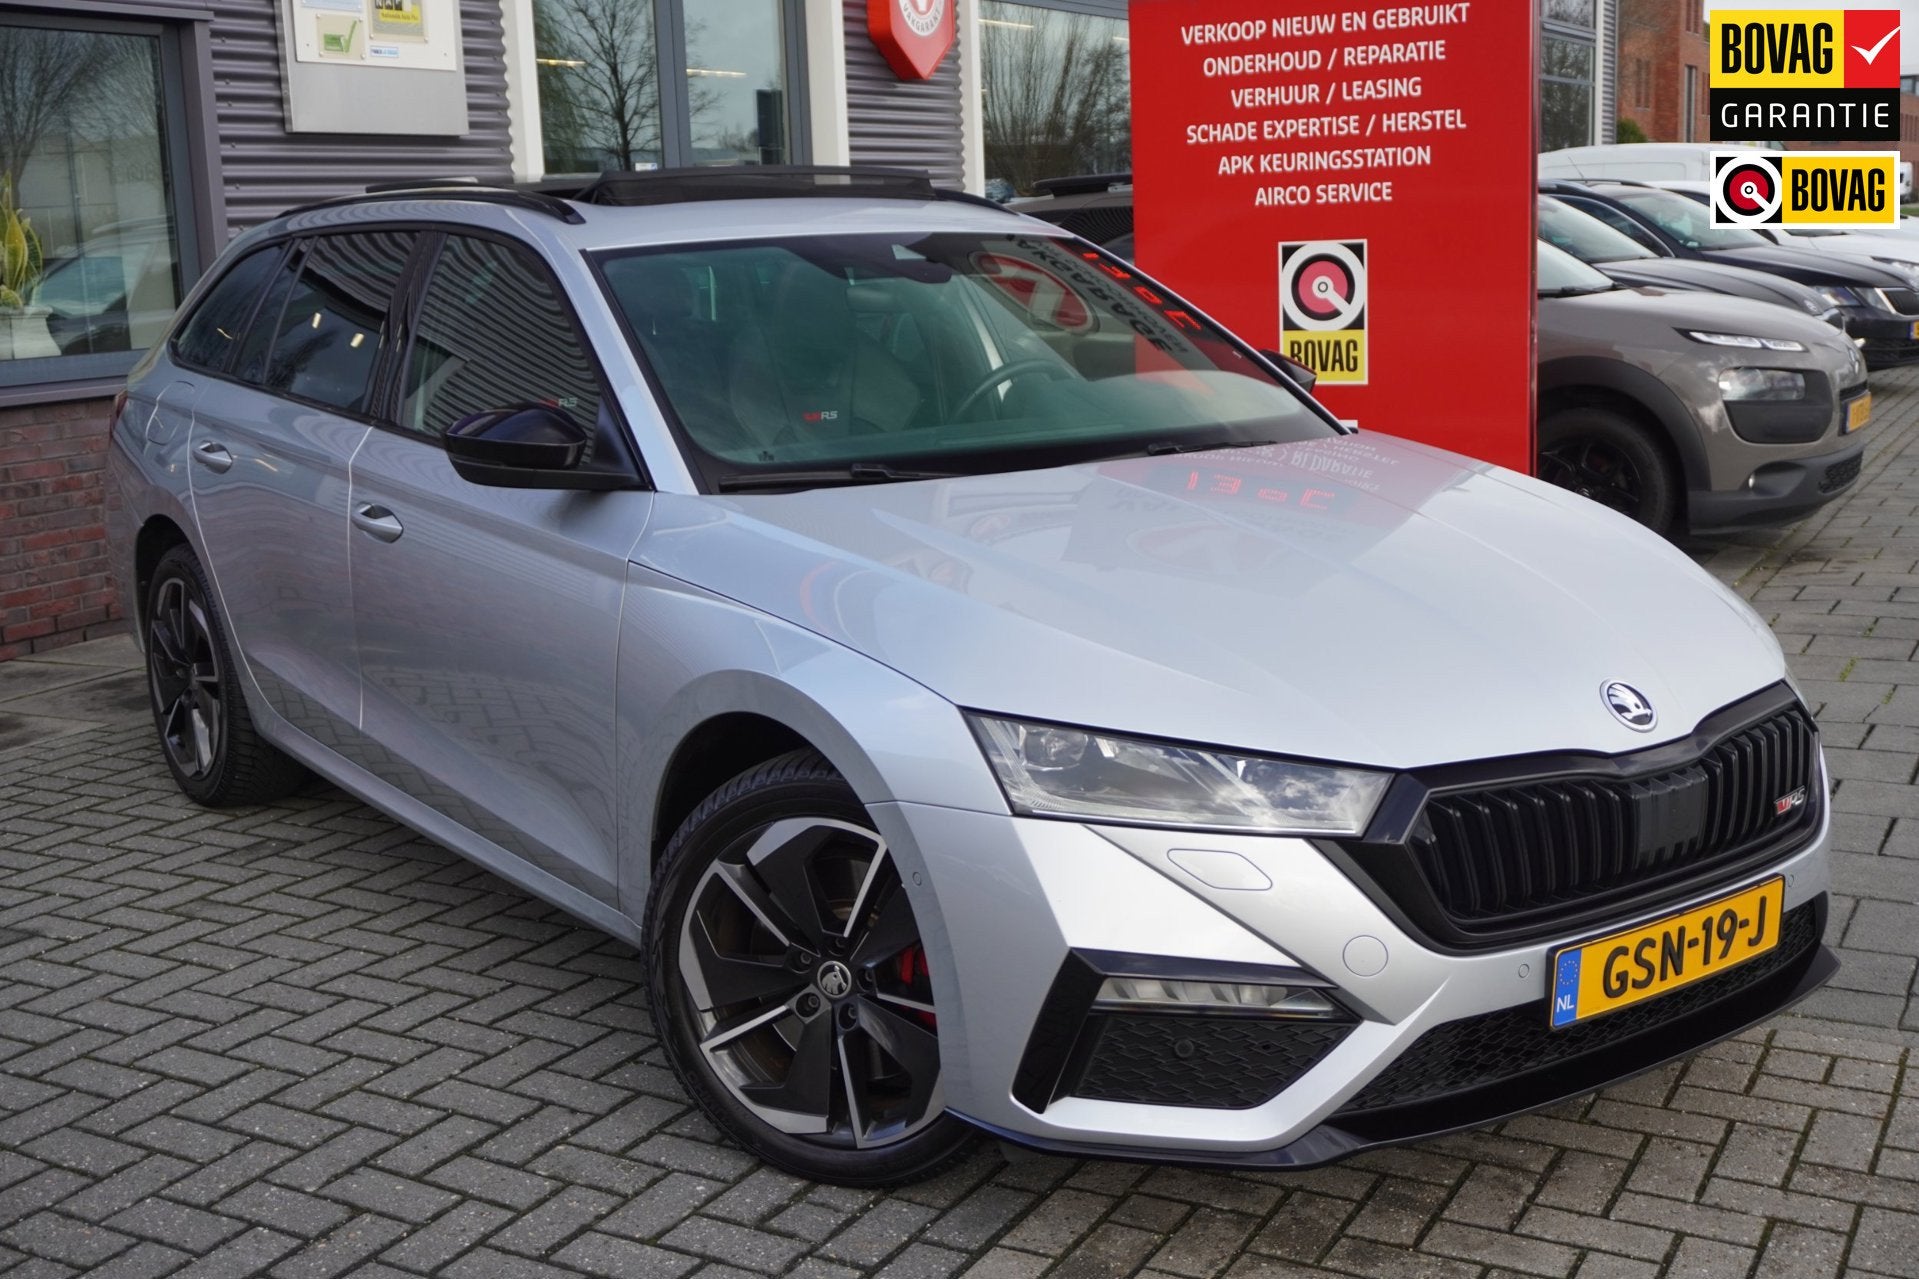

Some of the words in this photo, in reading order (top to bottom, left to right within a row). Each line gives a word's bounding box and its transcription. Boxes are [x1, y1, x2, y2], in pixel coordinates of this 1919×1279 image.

[1181, 19, 1267, 45] VERKOOP
[1272, 13, 1335, 38] NIEUW
[1342, 11, 1367, 31] EN
[1373, 2, 1470, 29] GEBRUIKT
[1203, 49, 1322, 77] ONDERHOUD
[1327, 48, 1338, 71] /
[1344, 39, 1446, 67] REPARATIE
[1231, 83, 1320, 108] VERHUUR
[1326, 82, 1337, 105] /
[1342, 76, 1422, 101] LEASING
[1187, 121, 1258, 145] SCHADE
[1263, 115, 1360, 139] EXPERTISE
[1366, 114, 1377, 137] /
[1383, 109, 1467, 134] HERSTEL
[1218, 155, 1255, 176] APK
[1260, 145, 1432, 174] KEURINGSSTATION
[1255, 186, 1311, 207] AIRCO
[1316, 181, 1393, 203] SERVICE
[1290, 339, 1359, 372] BOVAG
[1602, 895, 1767, 999] GSN-19-J
[1556, 994, 1575, 1013] NL
